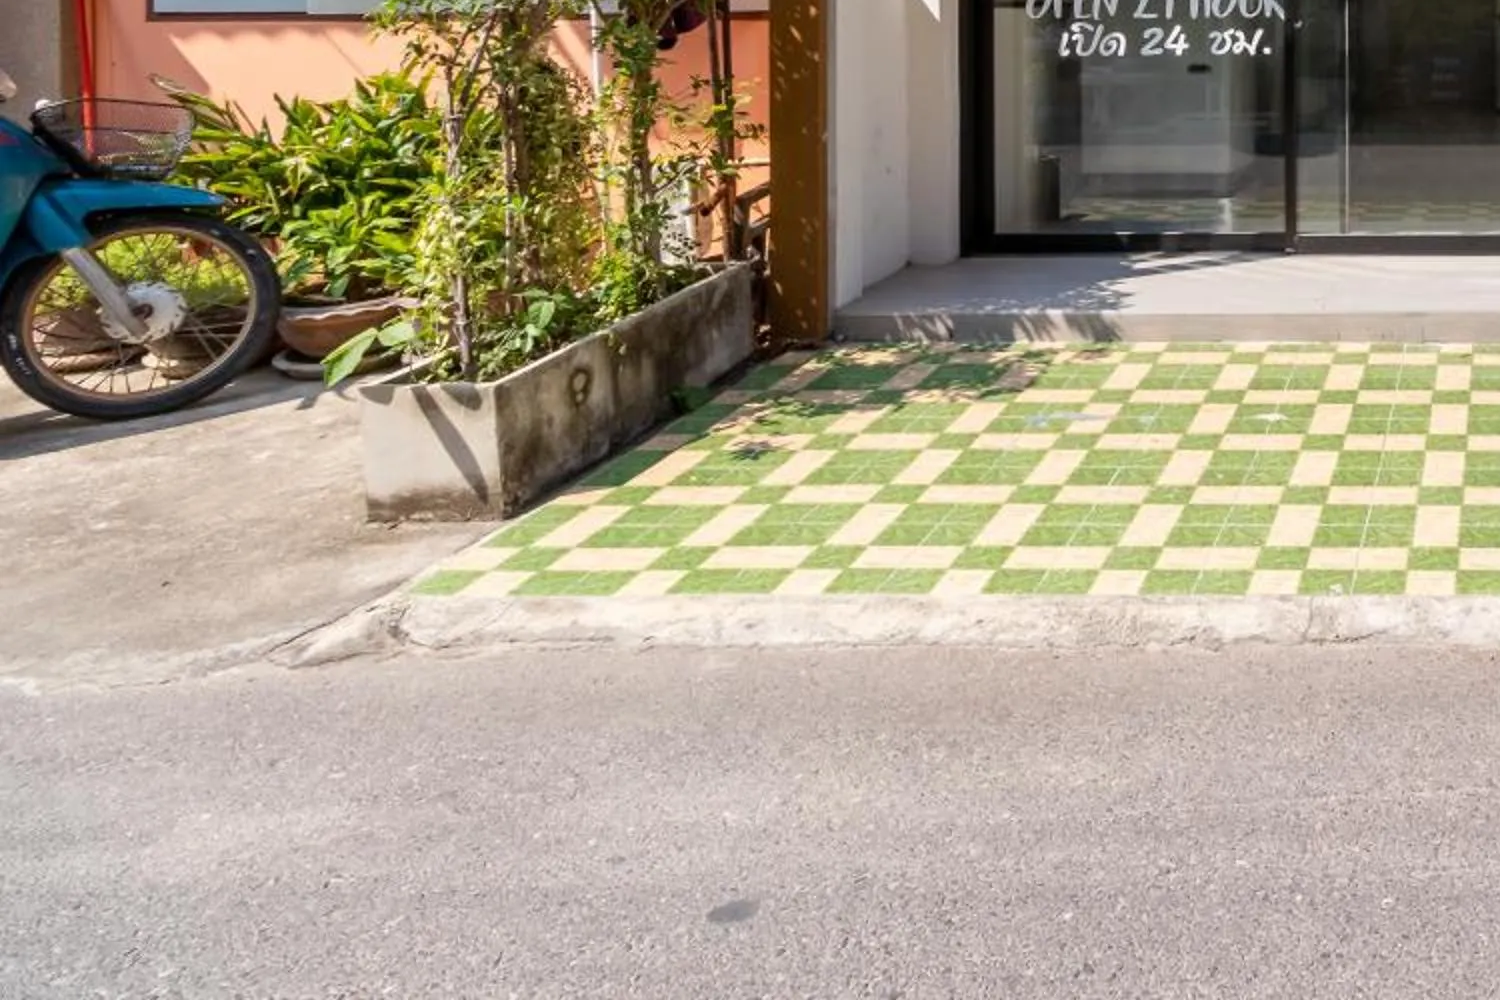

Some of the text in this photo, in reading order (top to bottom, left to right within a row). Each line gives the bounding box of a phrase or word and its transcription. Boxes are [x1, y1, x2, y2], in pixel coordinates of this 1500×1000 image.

[1059, 20, 1272, 57] เปิด 24 ชม.
